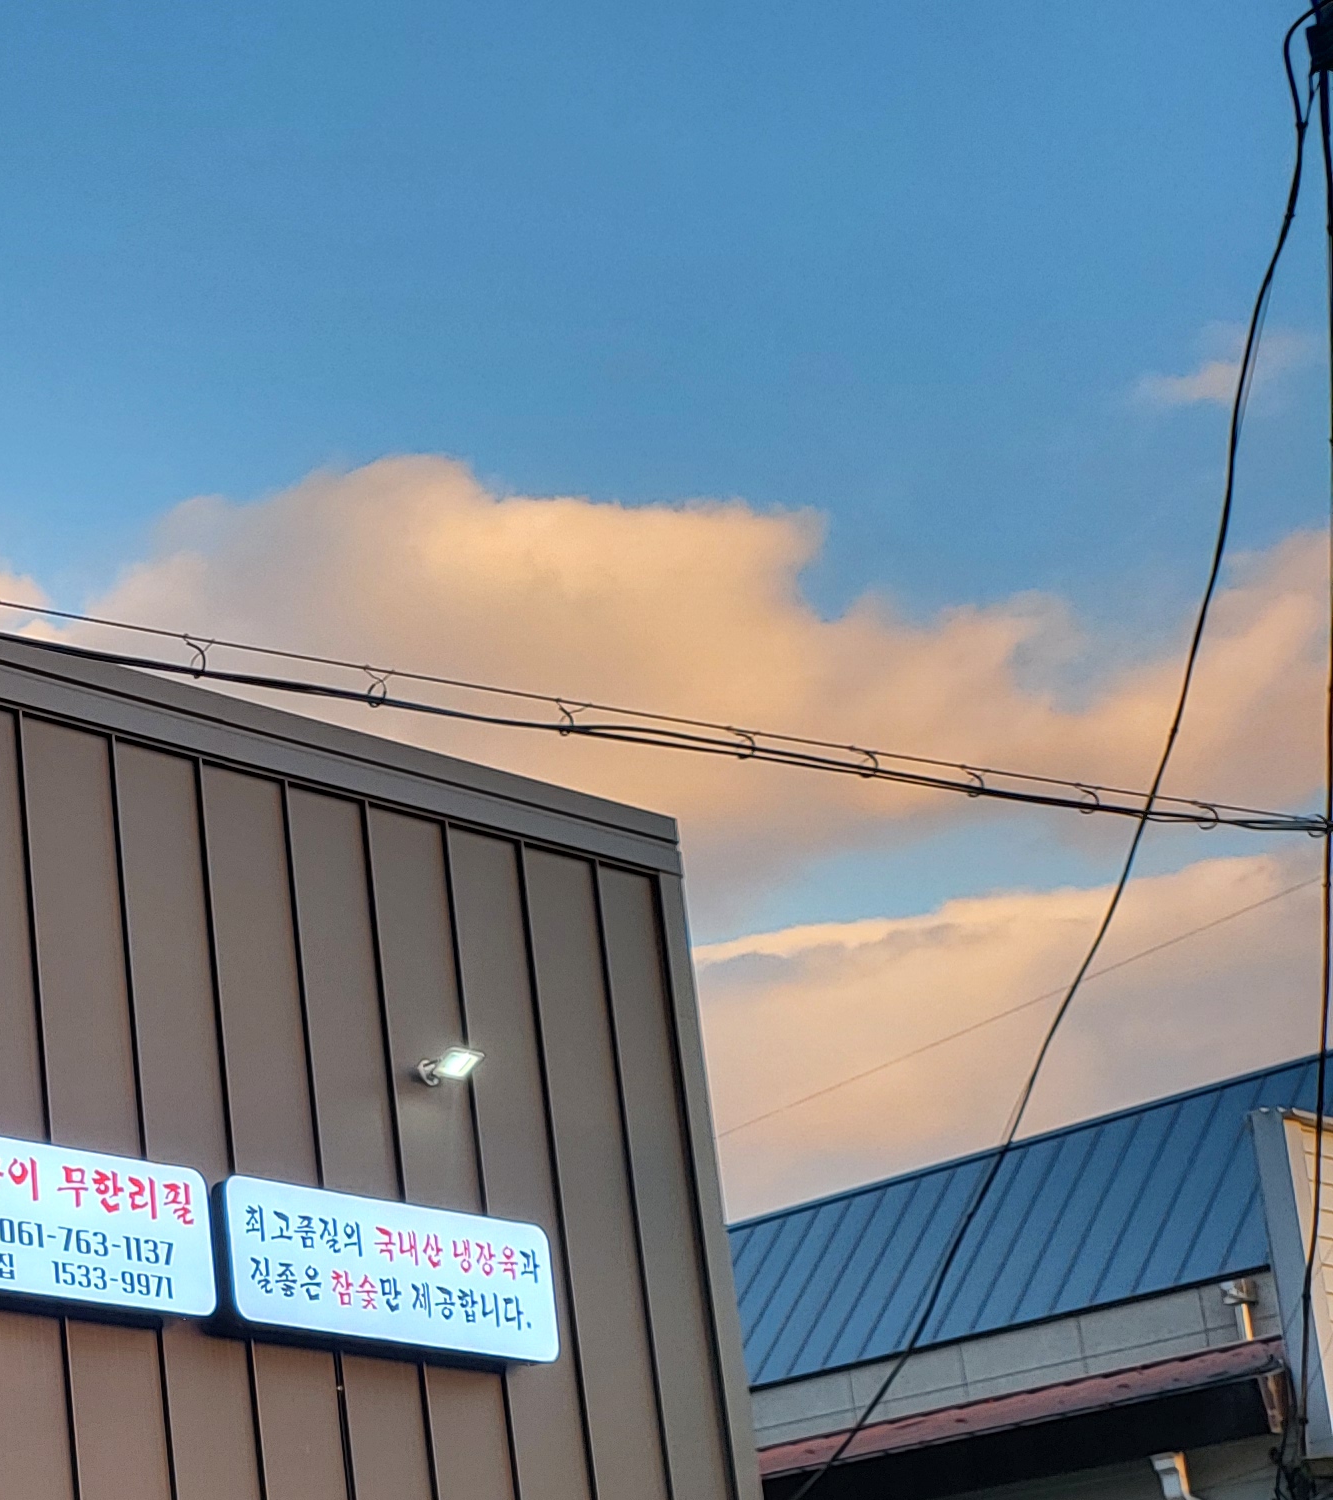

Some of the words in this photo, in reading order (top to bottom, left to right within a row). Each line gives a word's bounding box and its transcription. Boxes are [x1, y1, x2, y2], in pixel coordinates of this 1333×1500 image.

[57, 1166, 195, 1225] 무한리필
[245, 1204, 363, 1257] 최고품질의
[374, 1226, 443, 1269] 국내산
[451, 1238, 541, 1284] 냉장육과
[51, 1259, 174, 1300] 1533-9971
[250, 1256, 322, 1301] 질좋은
[331, 1269, 402, 1312] 참숯만
